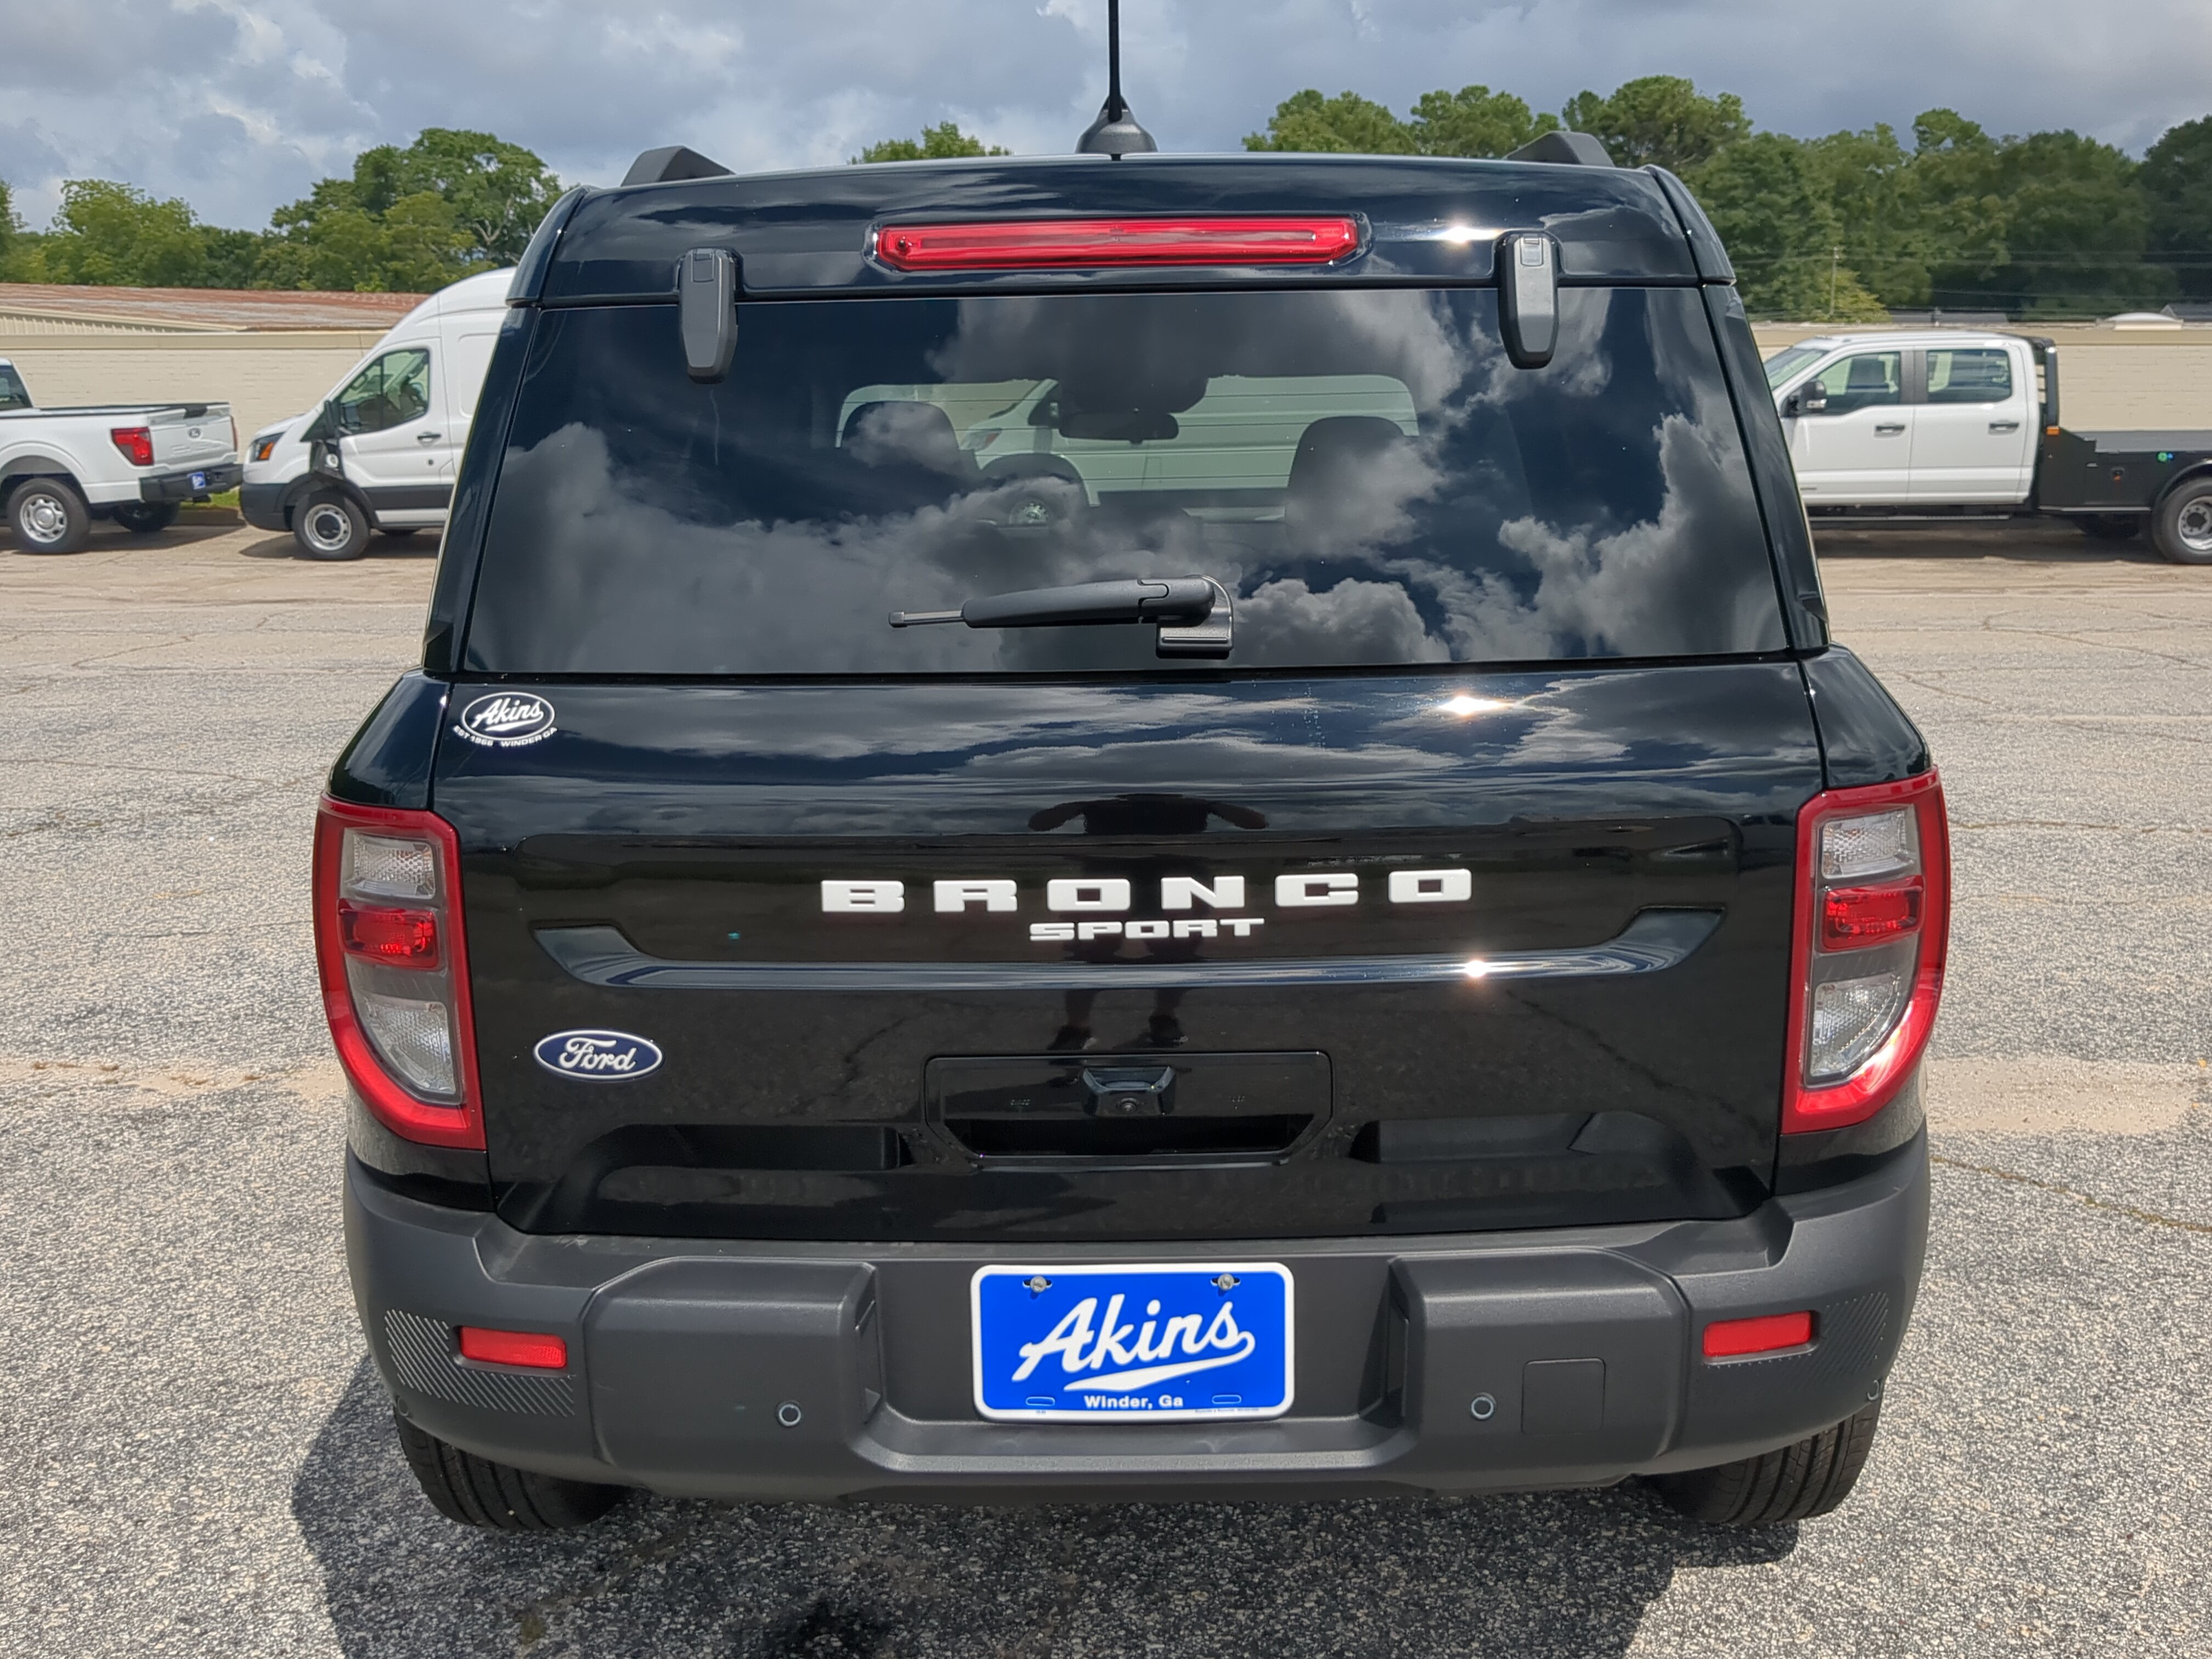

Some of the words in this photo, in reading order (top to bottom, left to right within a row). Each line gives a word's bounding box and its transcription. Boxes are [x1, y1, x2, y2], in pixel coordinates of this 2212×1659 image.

[471, 697, 544, 728] Akins
[453, 725, 470, 739] EST
[500, 735, 542, 747] WINDER
[542, 727, 558, 738] GA
[821, 868, 1472, 912] BRONCO
[1030, 918, 1264, 941] SPORT
[559, 1037, 637, 1070] Ford
[1011, 1293, 1256, 1382] Akins
[1084, 1395, 1153, 1409] Winder,
[1158, 1394, 1184, 1408] Ga
